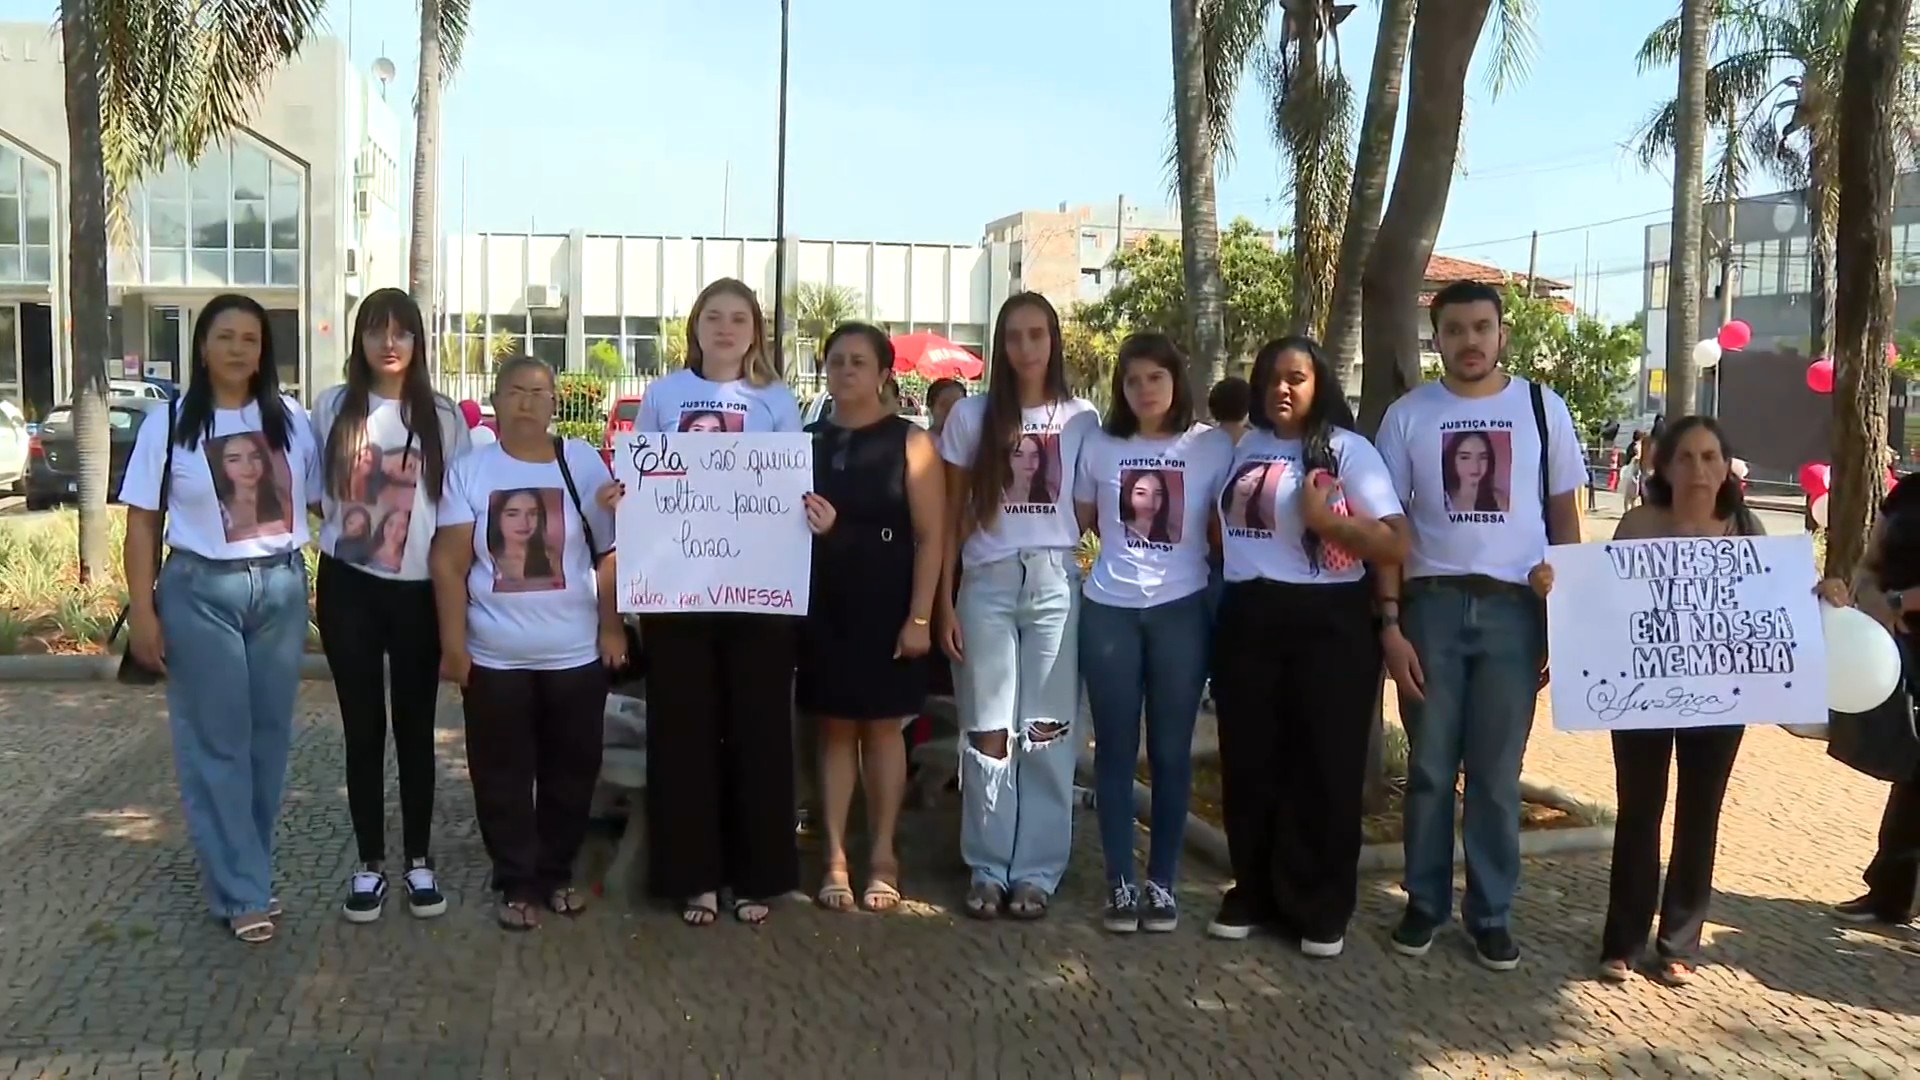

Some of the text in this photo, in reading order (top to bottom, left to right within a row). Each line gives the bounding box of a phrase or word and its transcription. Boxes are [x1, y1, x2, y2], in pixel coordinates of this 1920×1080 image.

[680, 400, 748, 412] JUSTIÇA POR
[1439, 419, 1513, 430] JUSTIÇA POR
[629, 434, 688, 490] Ela
[700, 441, 738, 472] só
[1118, 458, 1186, 468] JUSTIÇA POR
[727, 489, 790, 521] para
[1004, 504, 1057, 515] VANESSA
[1448, 512, 1506, 524] VANESSA
[706, 583, 794, 609] VANESSA
[1649, 577, 1739, 612] VIVE
[1630, 607, 1795, 645] EM NOSSA
